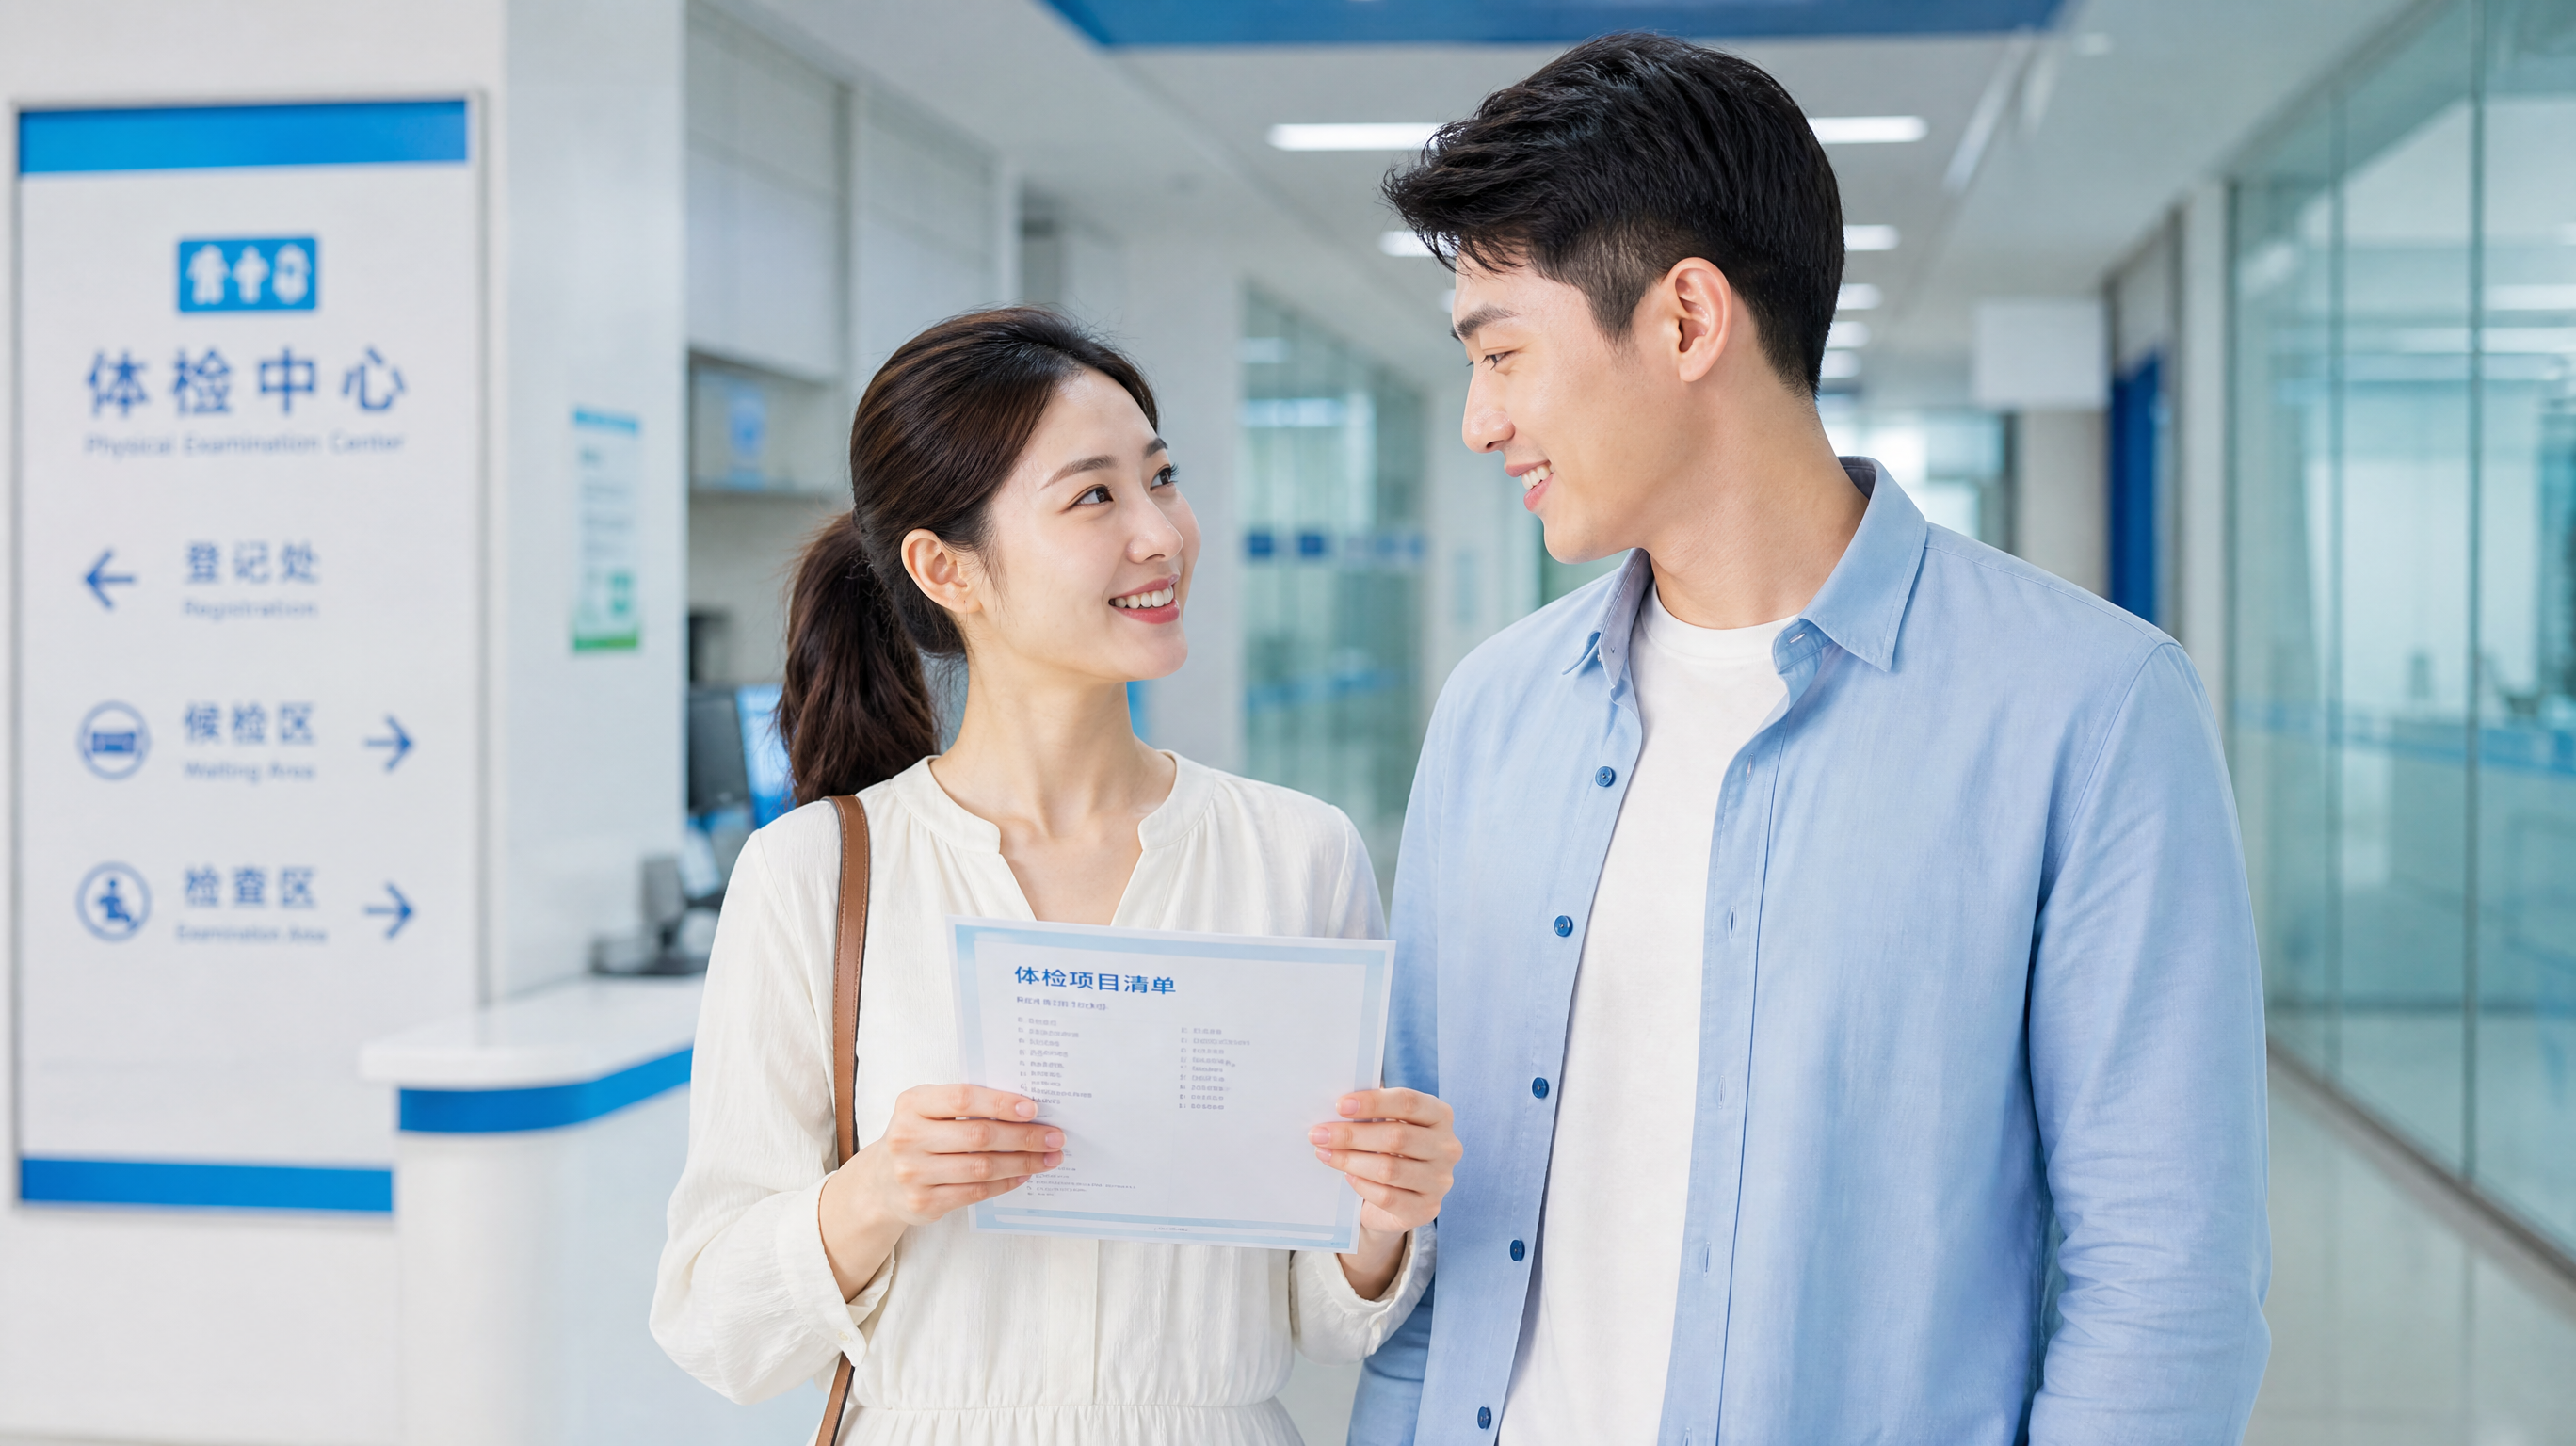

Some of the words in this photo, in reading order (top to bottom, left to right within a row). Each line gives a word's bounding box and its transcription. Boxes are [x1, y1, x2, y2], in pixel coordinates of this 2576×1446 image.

[86, 347, 406, 417] 体检中心
[186, 542, 318, 584] 登记处
[184, 703, 314, 744] 候检区
[184, 866, 314, 908] 检查区
[1015, 966, 1176, 994] 体检项目清单
